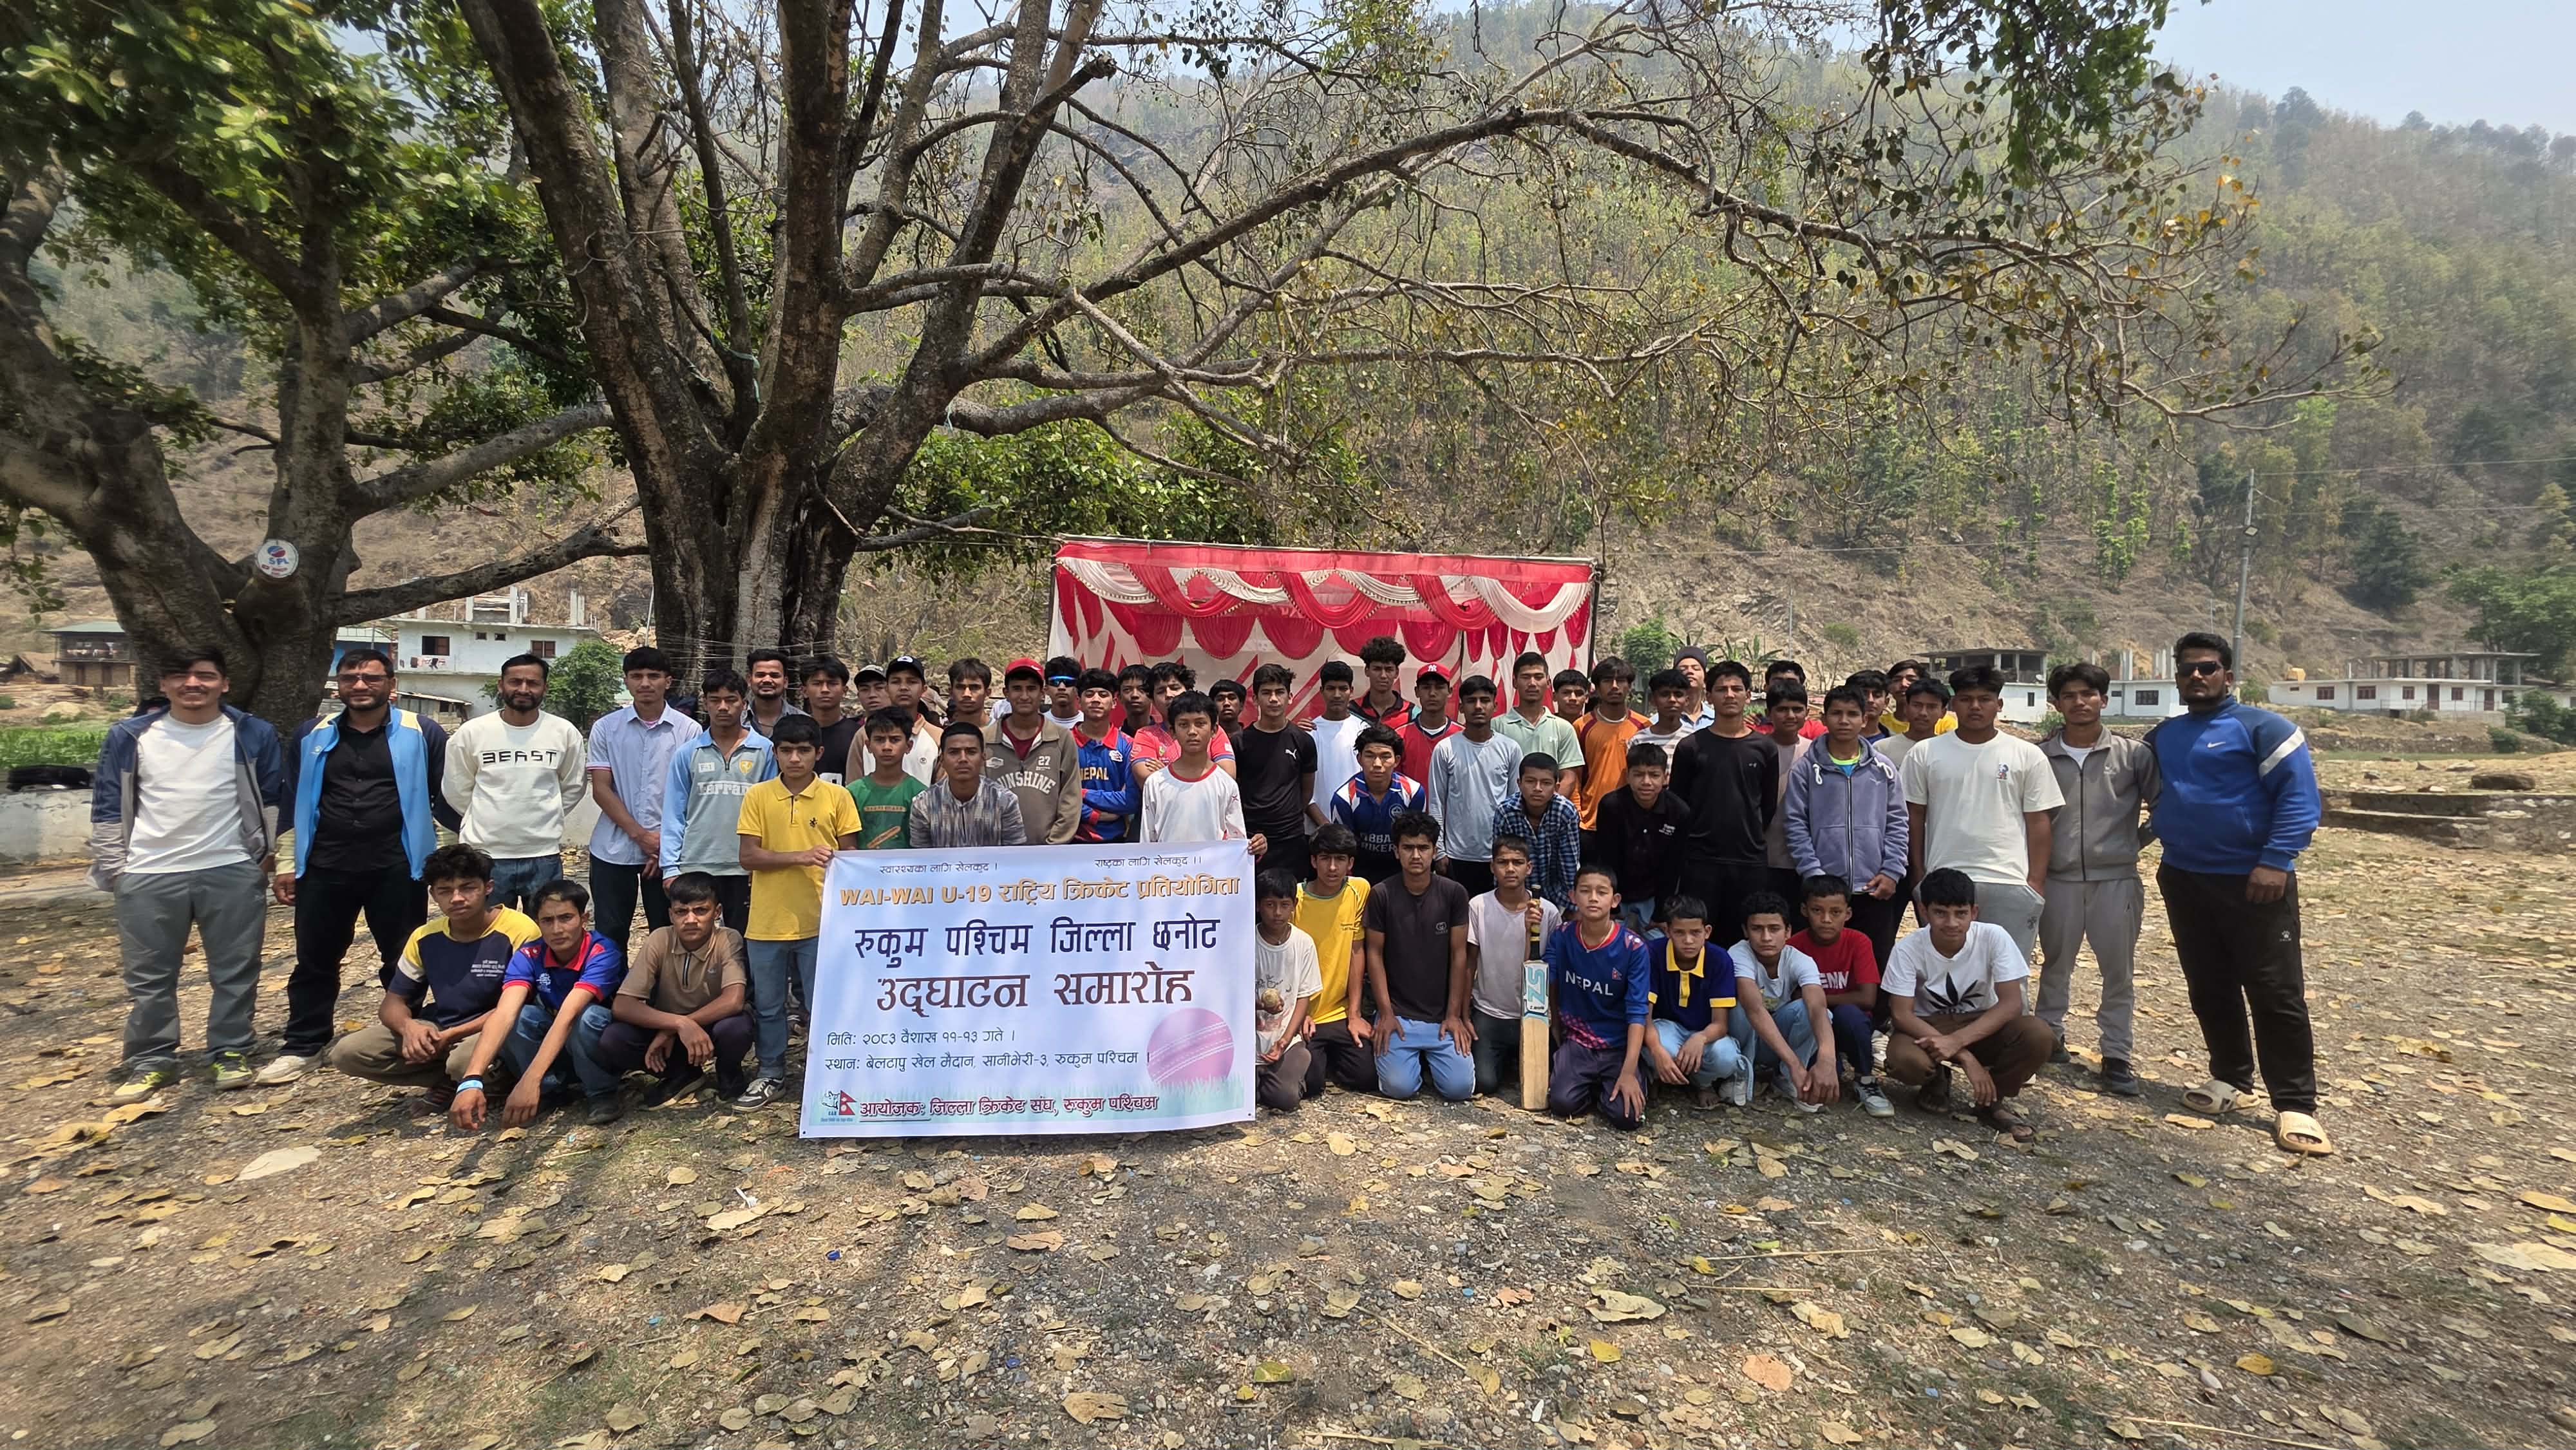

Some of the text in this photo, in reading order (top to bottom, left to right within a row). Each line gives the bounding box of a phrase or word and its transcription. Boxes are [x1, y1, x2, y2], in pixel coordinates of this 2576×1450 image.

[1037, 756, 1051, 766] 27
[998, 771, 1056, 795] UNSHINE
[930, 863, 951, 872] लागि
[1128, 857, 1150, 866] लागि
[1154, 855, 1188, 867] खेलकुद
[840, 886, 934, 906] WAI-WAI
[942, 885, 992, 903] U-19
[1063, 876, 1130, 900] क्रिकेट
[1136, 873, 1240, 900] प्रतियोगिता
[855, 912, 1220, 968] रुकुम पश्चिम जिल्ला छनोट
[1054, 961, 1195, 1005] समारोह
[1566, 970, 1613, 995] NEPAL
[863, 1033, 896, 1044] २०८३
[902, 1028, 938, 1043] वैशाख
[942, 1031, 978, 1043] ११-१३
[983, 1027, 1003, 1041] गते
[866, 1054, 907, 1072] बेलटापु
[912, 1053, 936, 1068] खेल
[940, 1051, 976, 1068] मैदान,
[1055, 1053, 1092, 1068] रुकुम
[1097, 1050, 1139, 1064] पश्चिम
[930, 1097, 974, 1115] जिल्ला
[979, 1097, 1026, 1115] क्रिकेट
[1030, 1096, 1058, 1118] संघ,
[1108, 1093, 1159, 1113] पश्चिम
